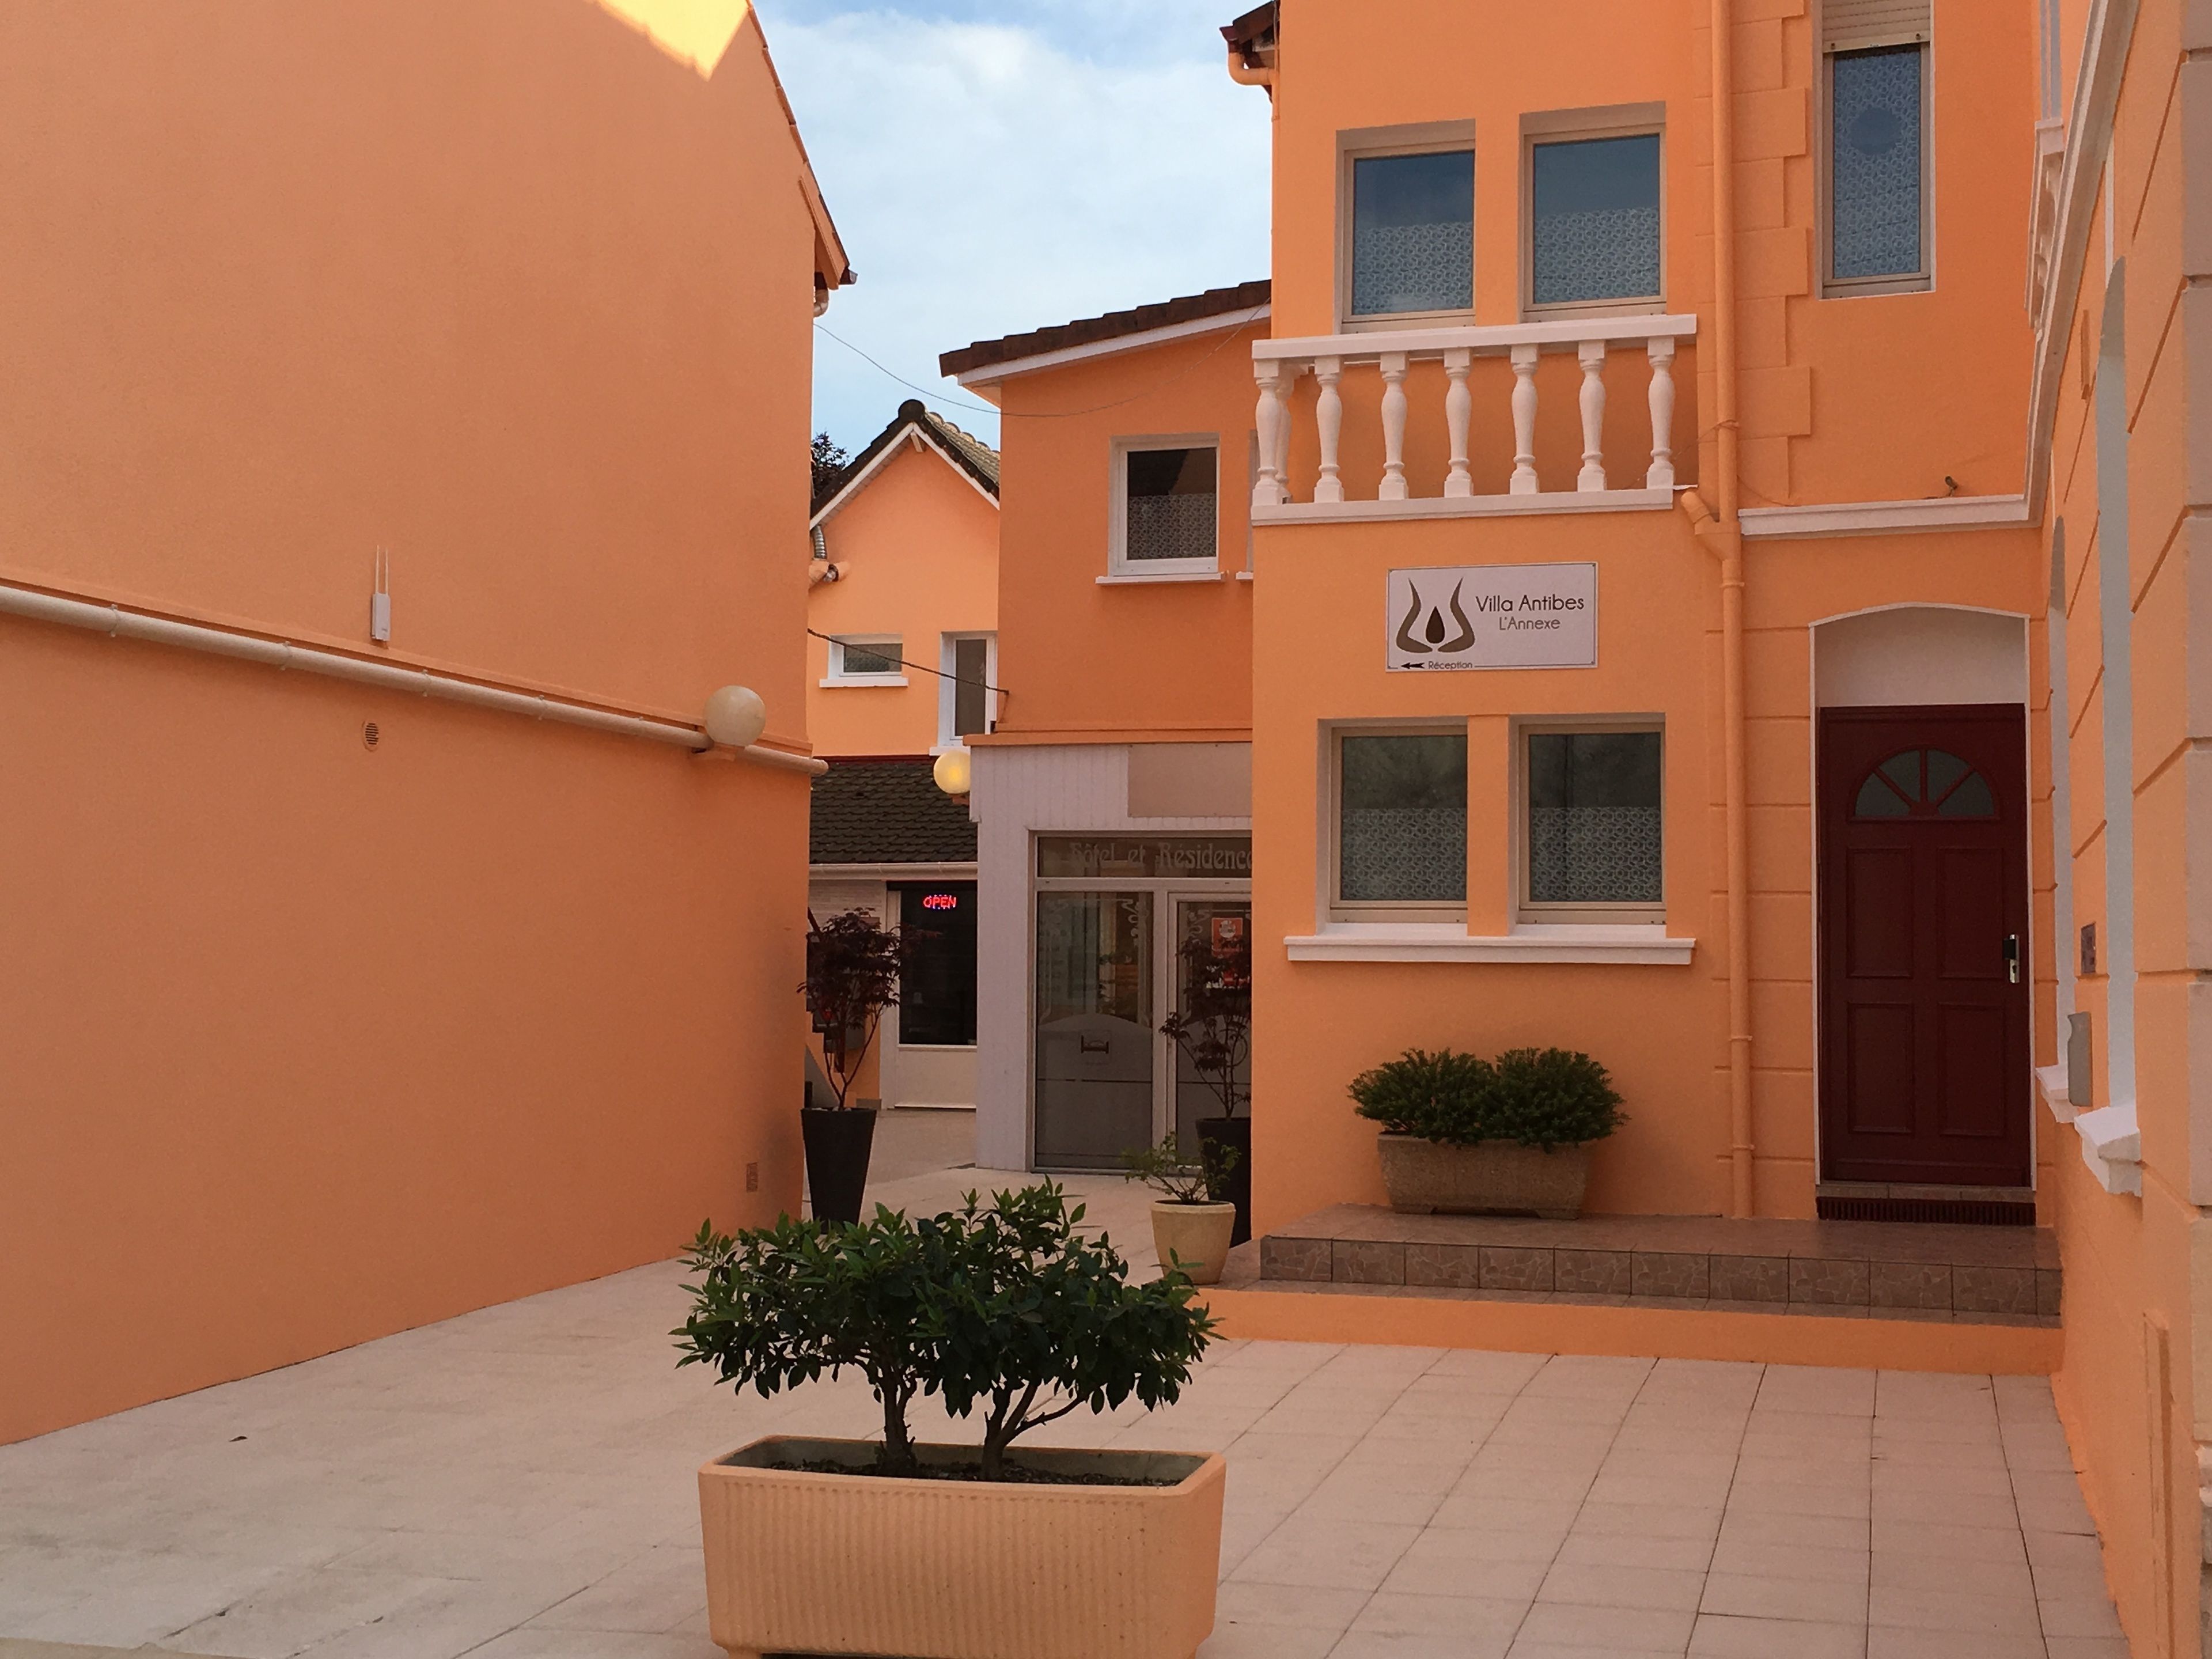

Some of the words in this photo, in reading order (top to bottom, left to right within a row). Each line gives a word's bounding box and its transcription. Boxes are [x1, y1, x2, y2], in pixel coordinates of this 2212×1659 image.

[1475, 595, 1513, 612] Villa
[1518, 594, 1585, 611] Antibes
[1499, 616, 1560, 630] L'Annexe
[1429, 661, 1472, 670] Réception
[923, 896, 957, 908] OPEN
